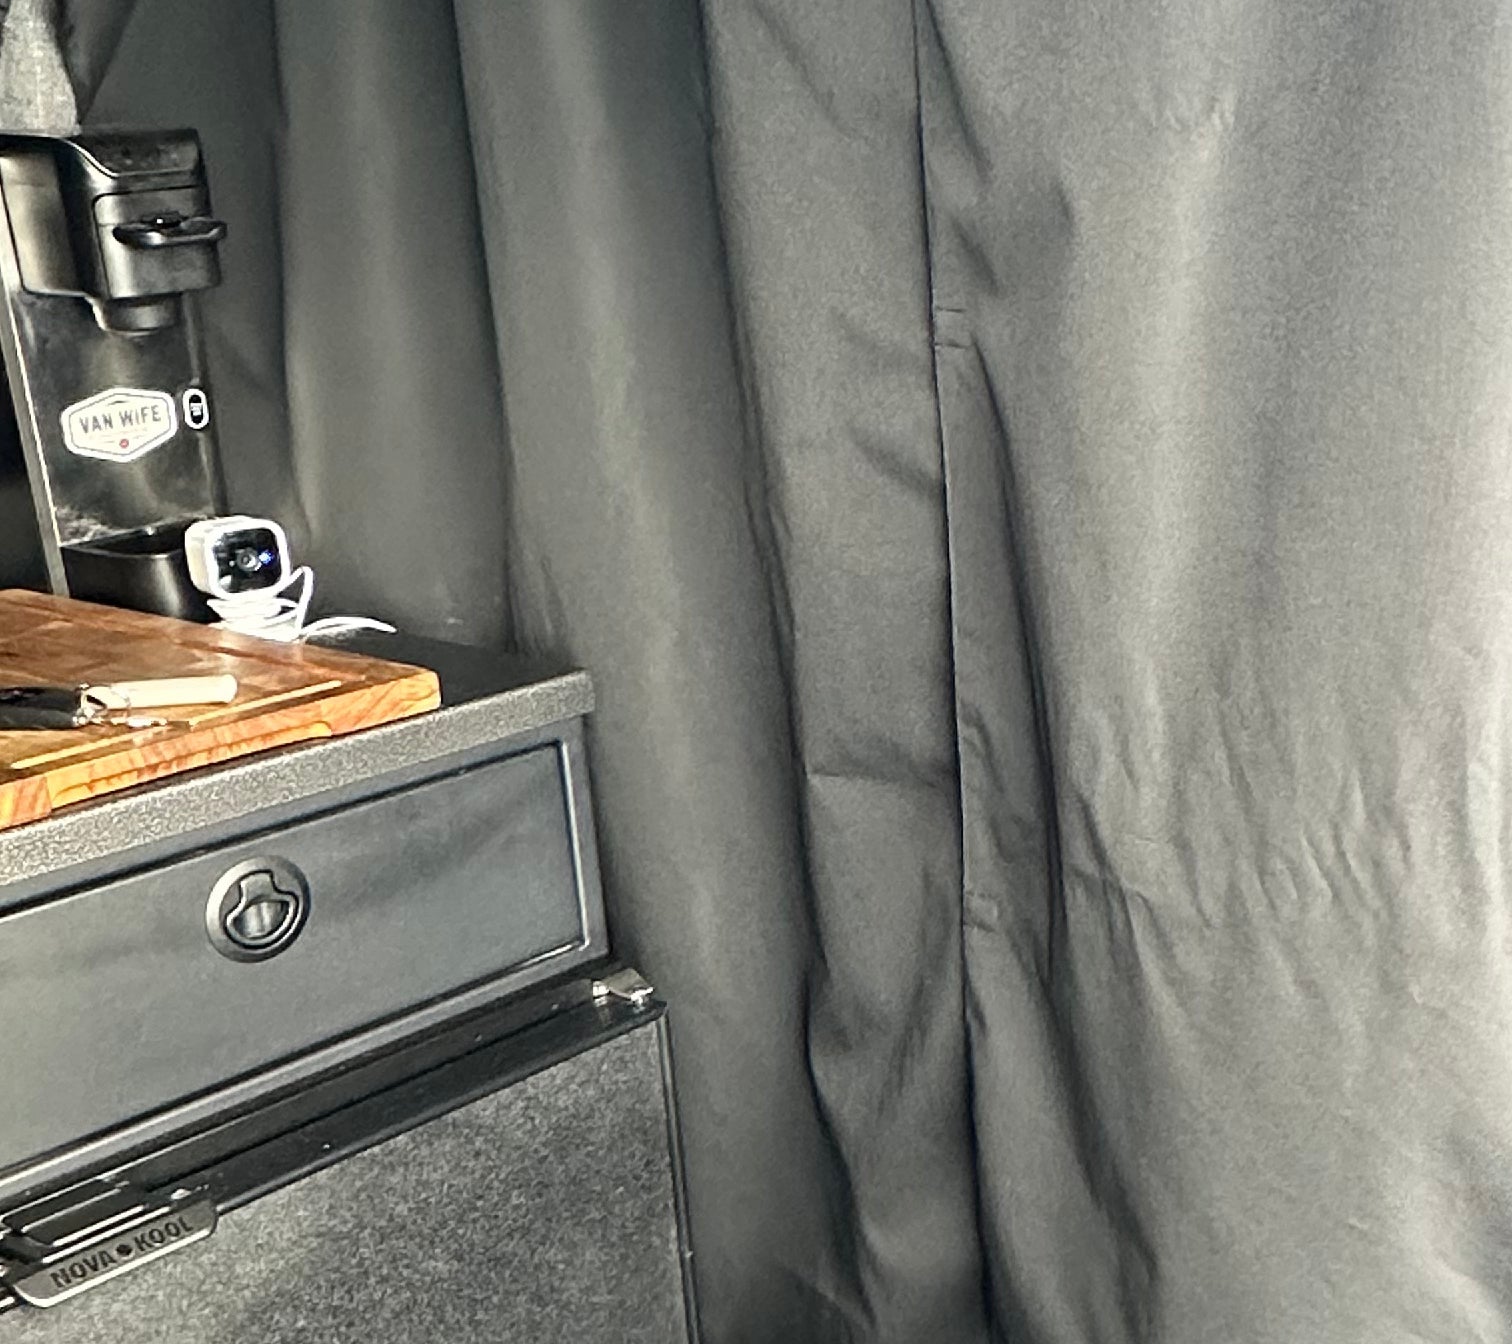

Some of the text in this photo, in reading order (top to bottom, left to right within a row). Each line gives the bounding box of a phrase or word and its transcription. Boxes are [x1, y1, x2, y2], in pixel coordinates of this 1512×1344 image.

[79, 405, 161, 434] VAN WIFE
[50, 1216, 194, 1288] NOVA KOOL
